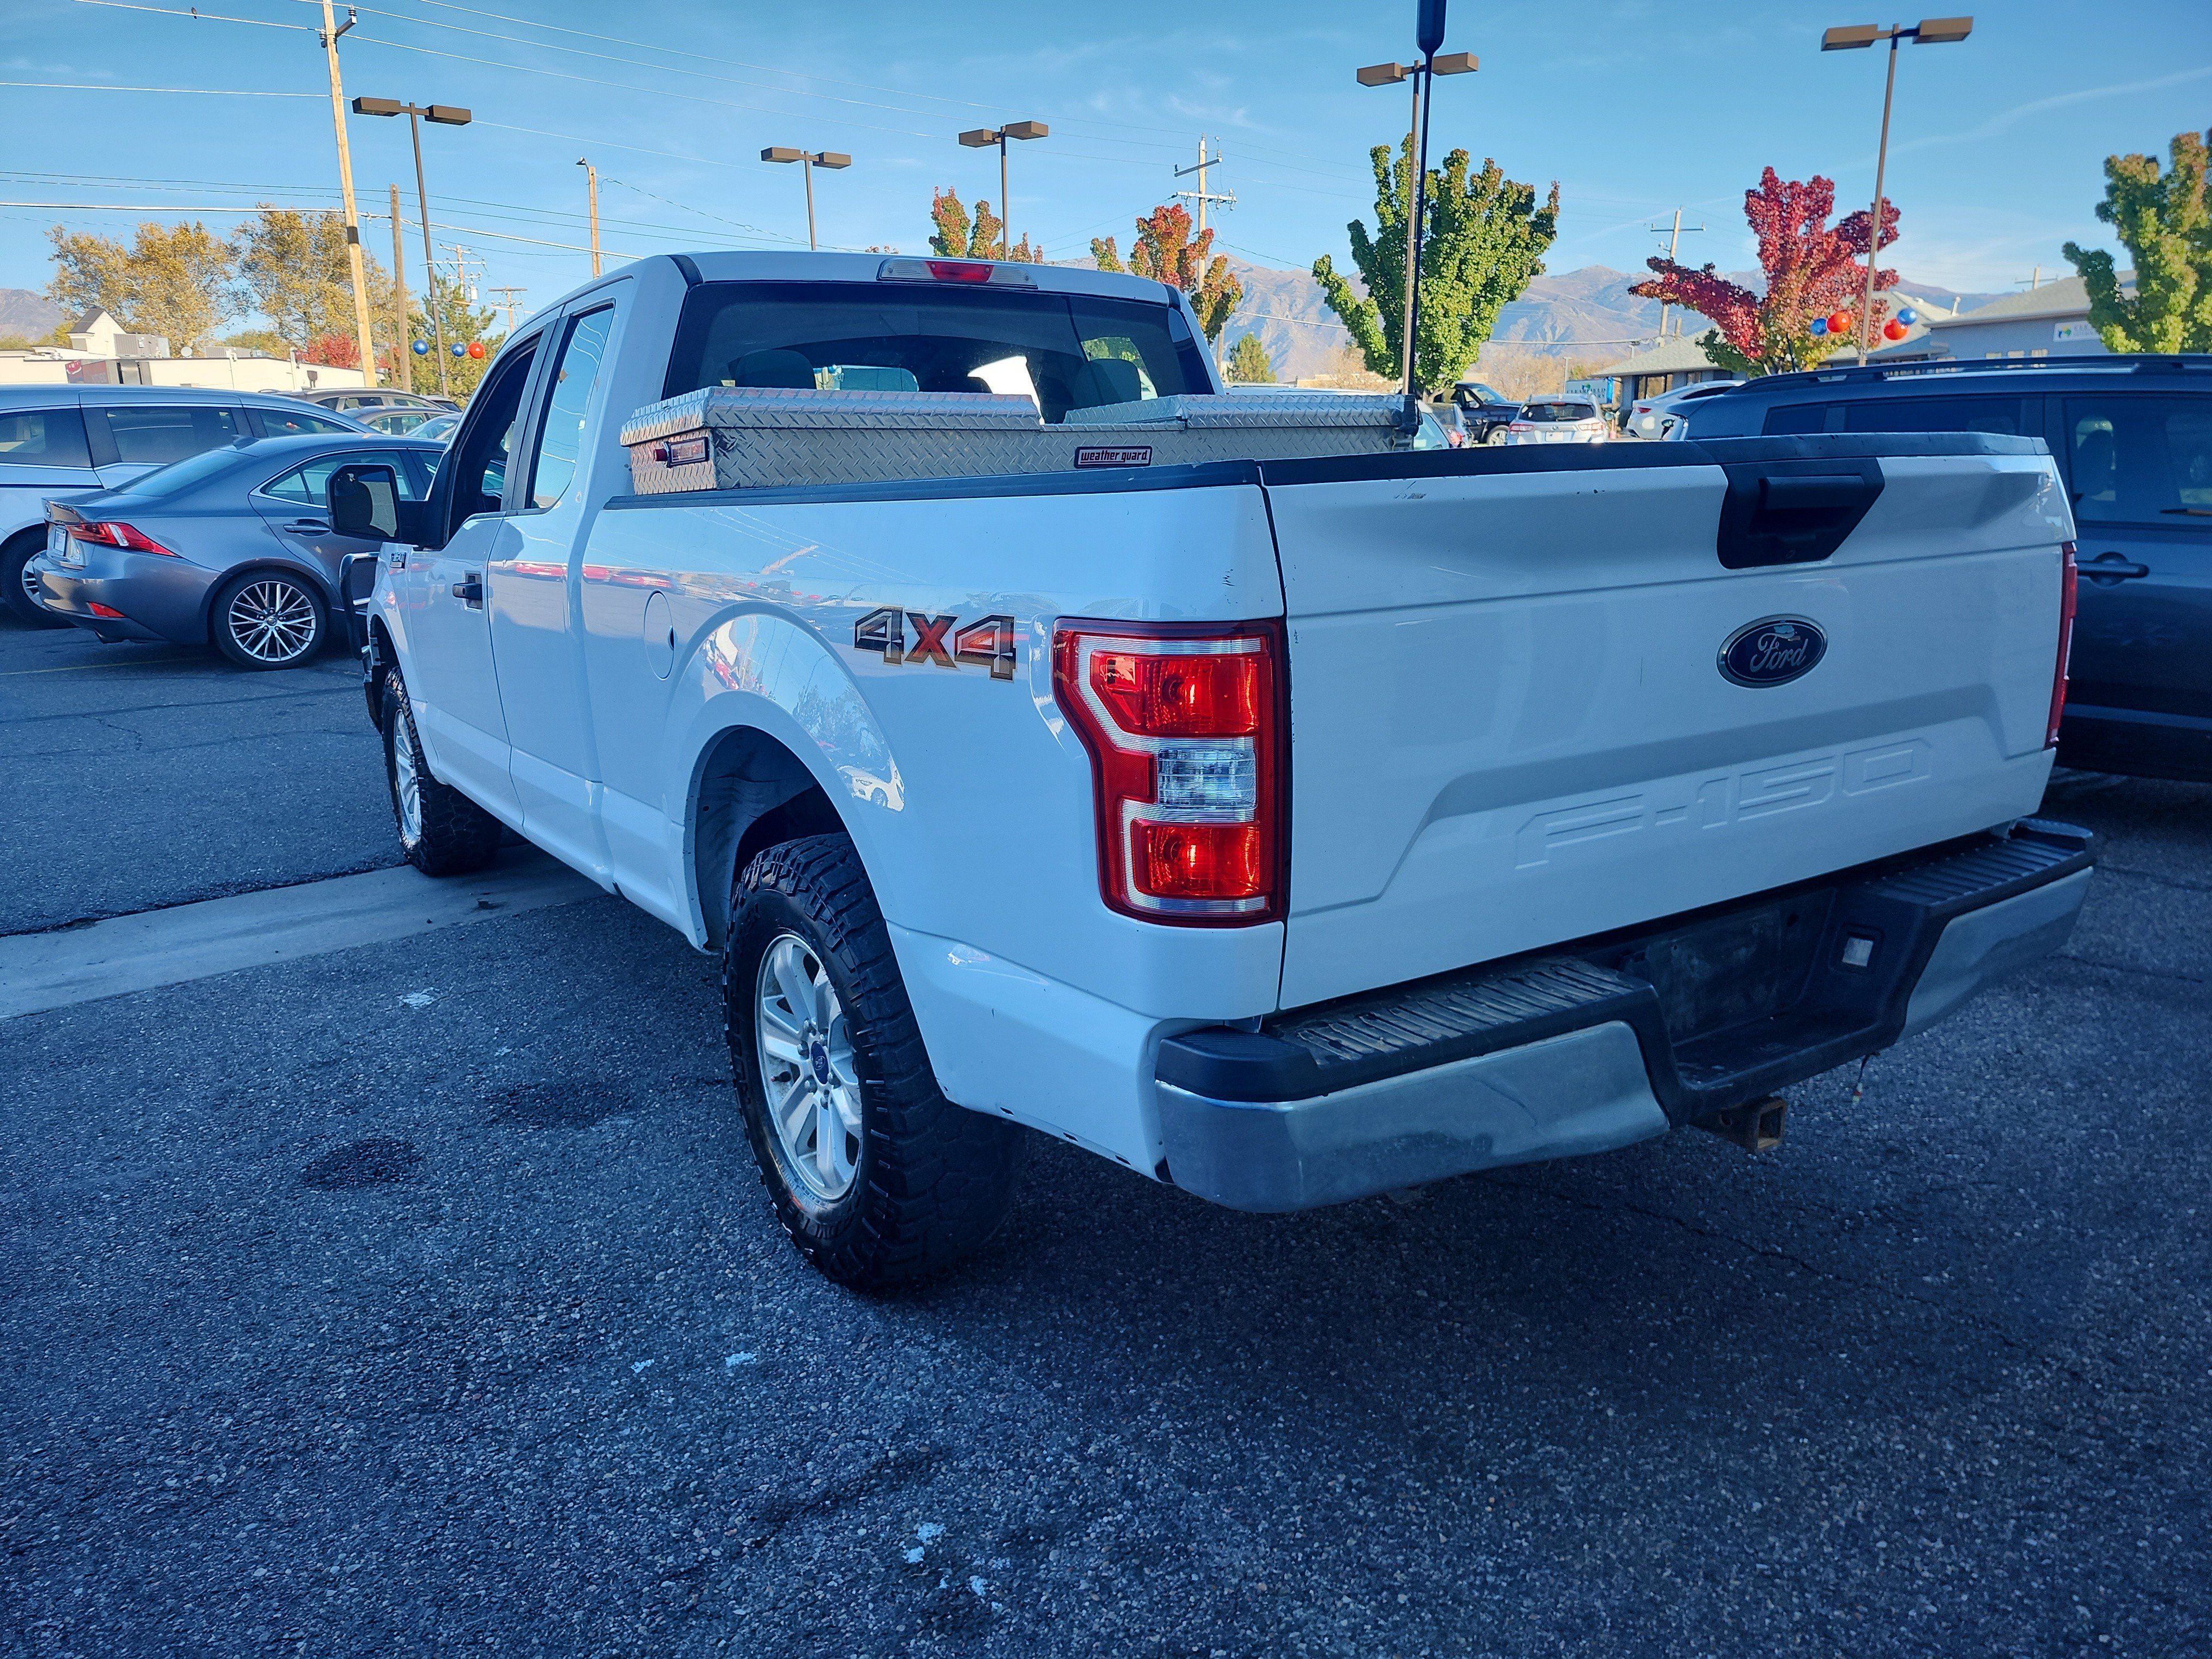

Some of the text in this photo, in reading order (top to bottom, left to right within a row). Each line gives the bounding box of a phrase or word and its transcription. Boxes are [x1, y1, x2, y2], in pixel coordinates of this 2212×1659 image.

[1081, 450, 1148, 462] weather guard
[1750, 633, 1809, 673] Ford
[1516, 737, 1932, 869] F-150
